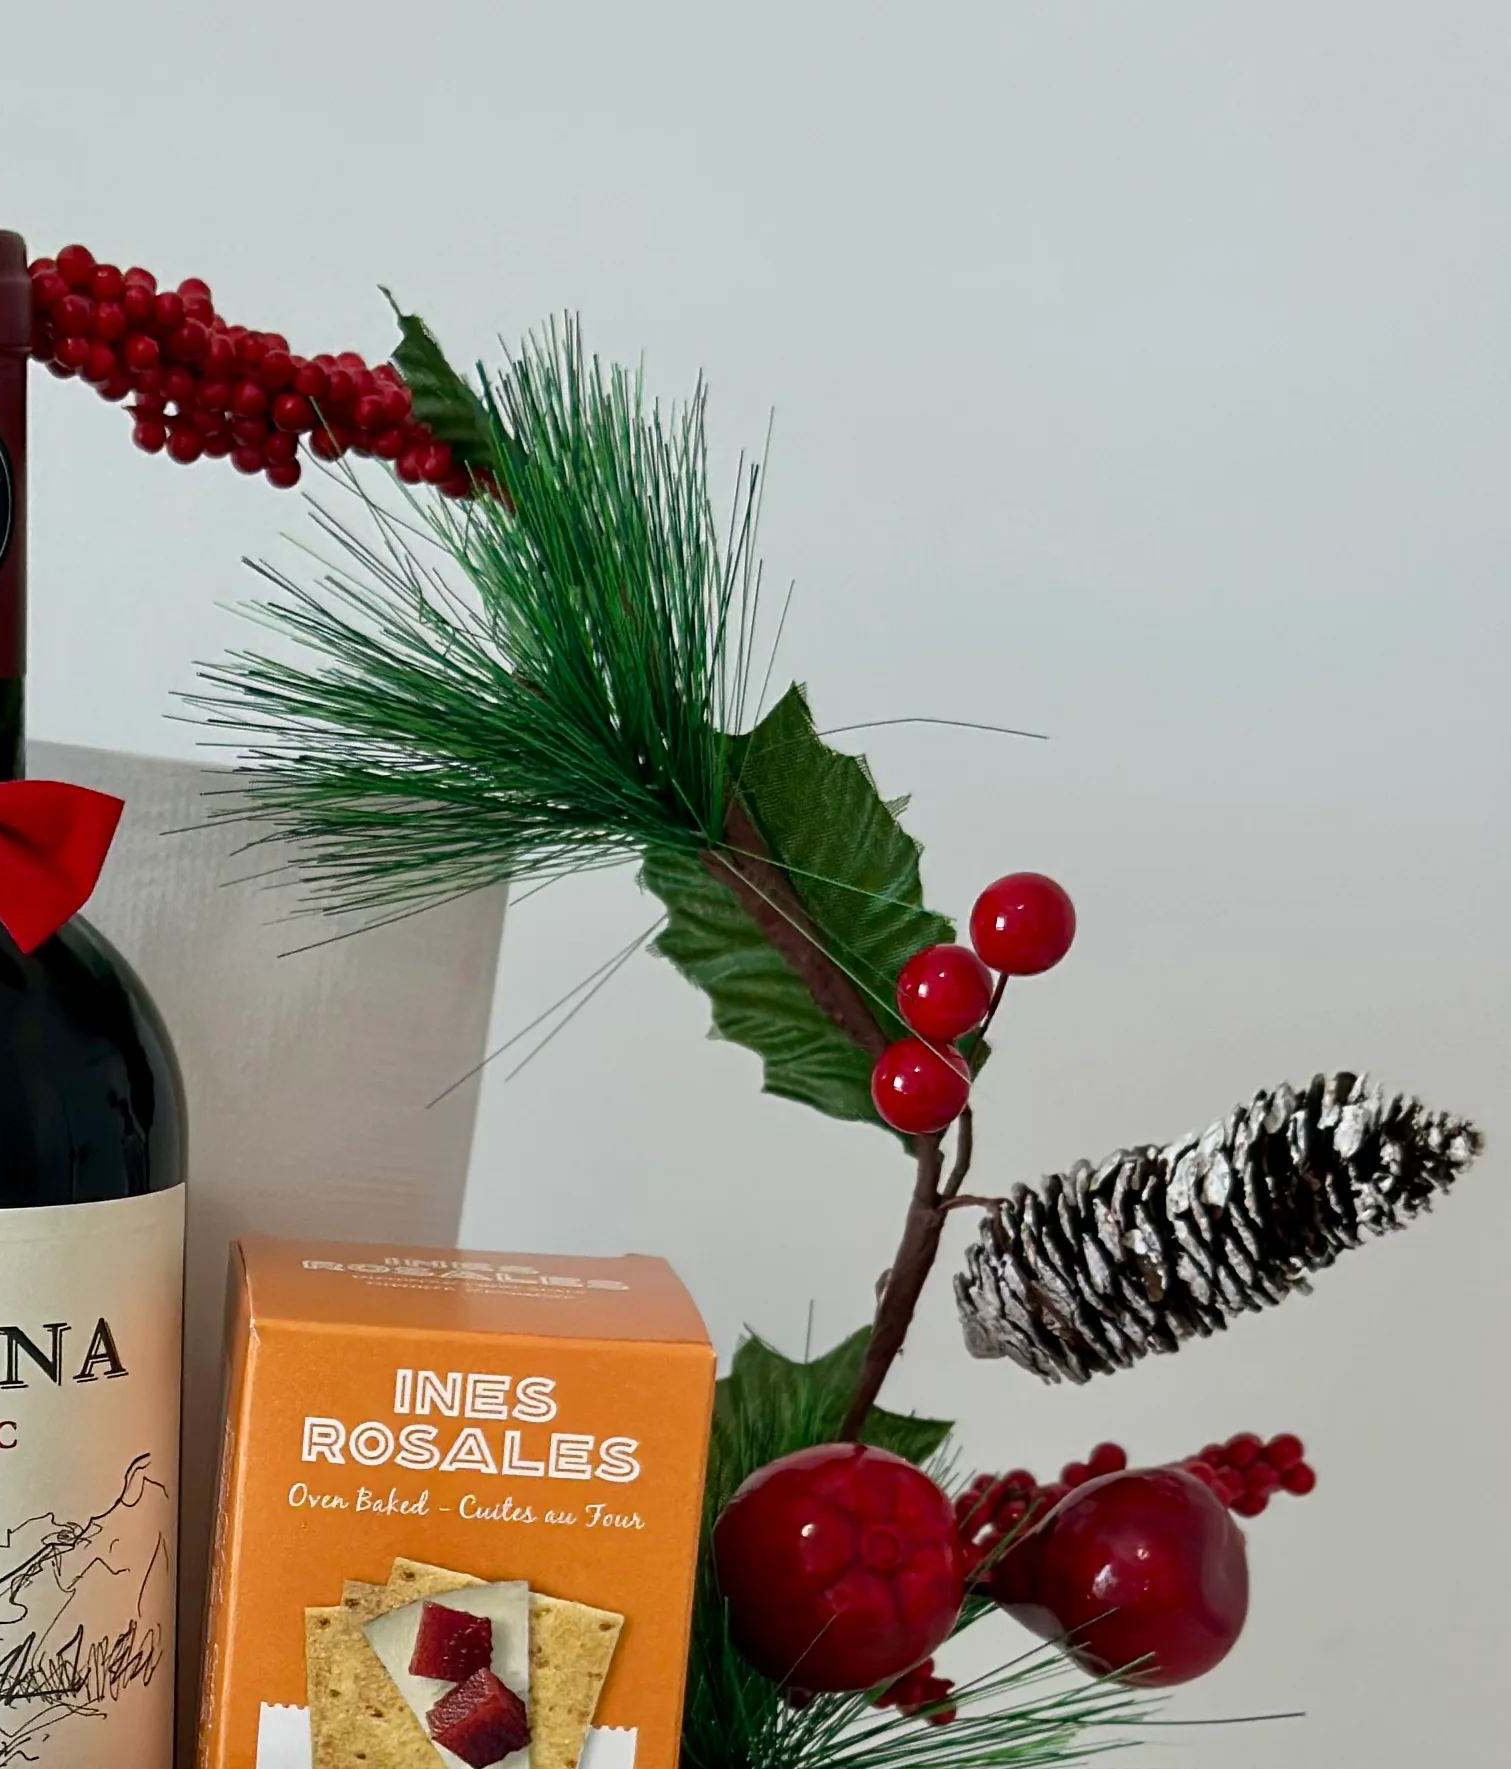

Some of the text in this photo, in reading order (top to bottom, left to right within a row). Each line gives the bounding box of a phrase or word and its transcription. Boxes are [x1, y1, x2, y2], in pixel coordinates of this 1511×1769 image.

[393, 1367, 558, 1424] INES
[300, 1416, 641, 1484] ROSALES
[288, 1482, 350, 1511] Oven
[355, 1485, 429, 1517] Baked
[459, 1493, 537, 1526] Cuites
[545, 1512, 576, 1527] au
[583, 1502, 645, 1531] Four
